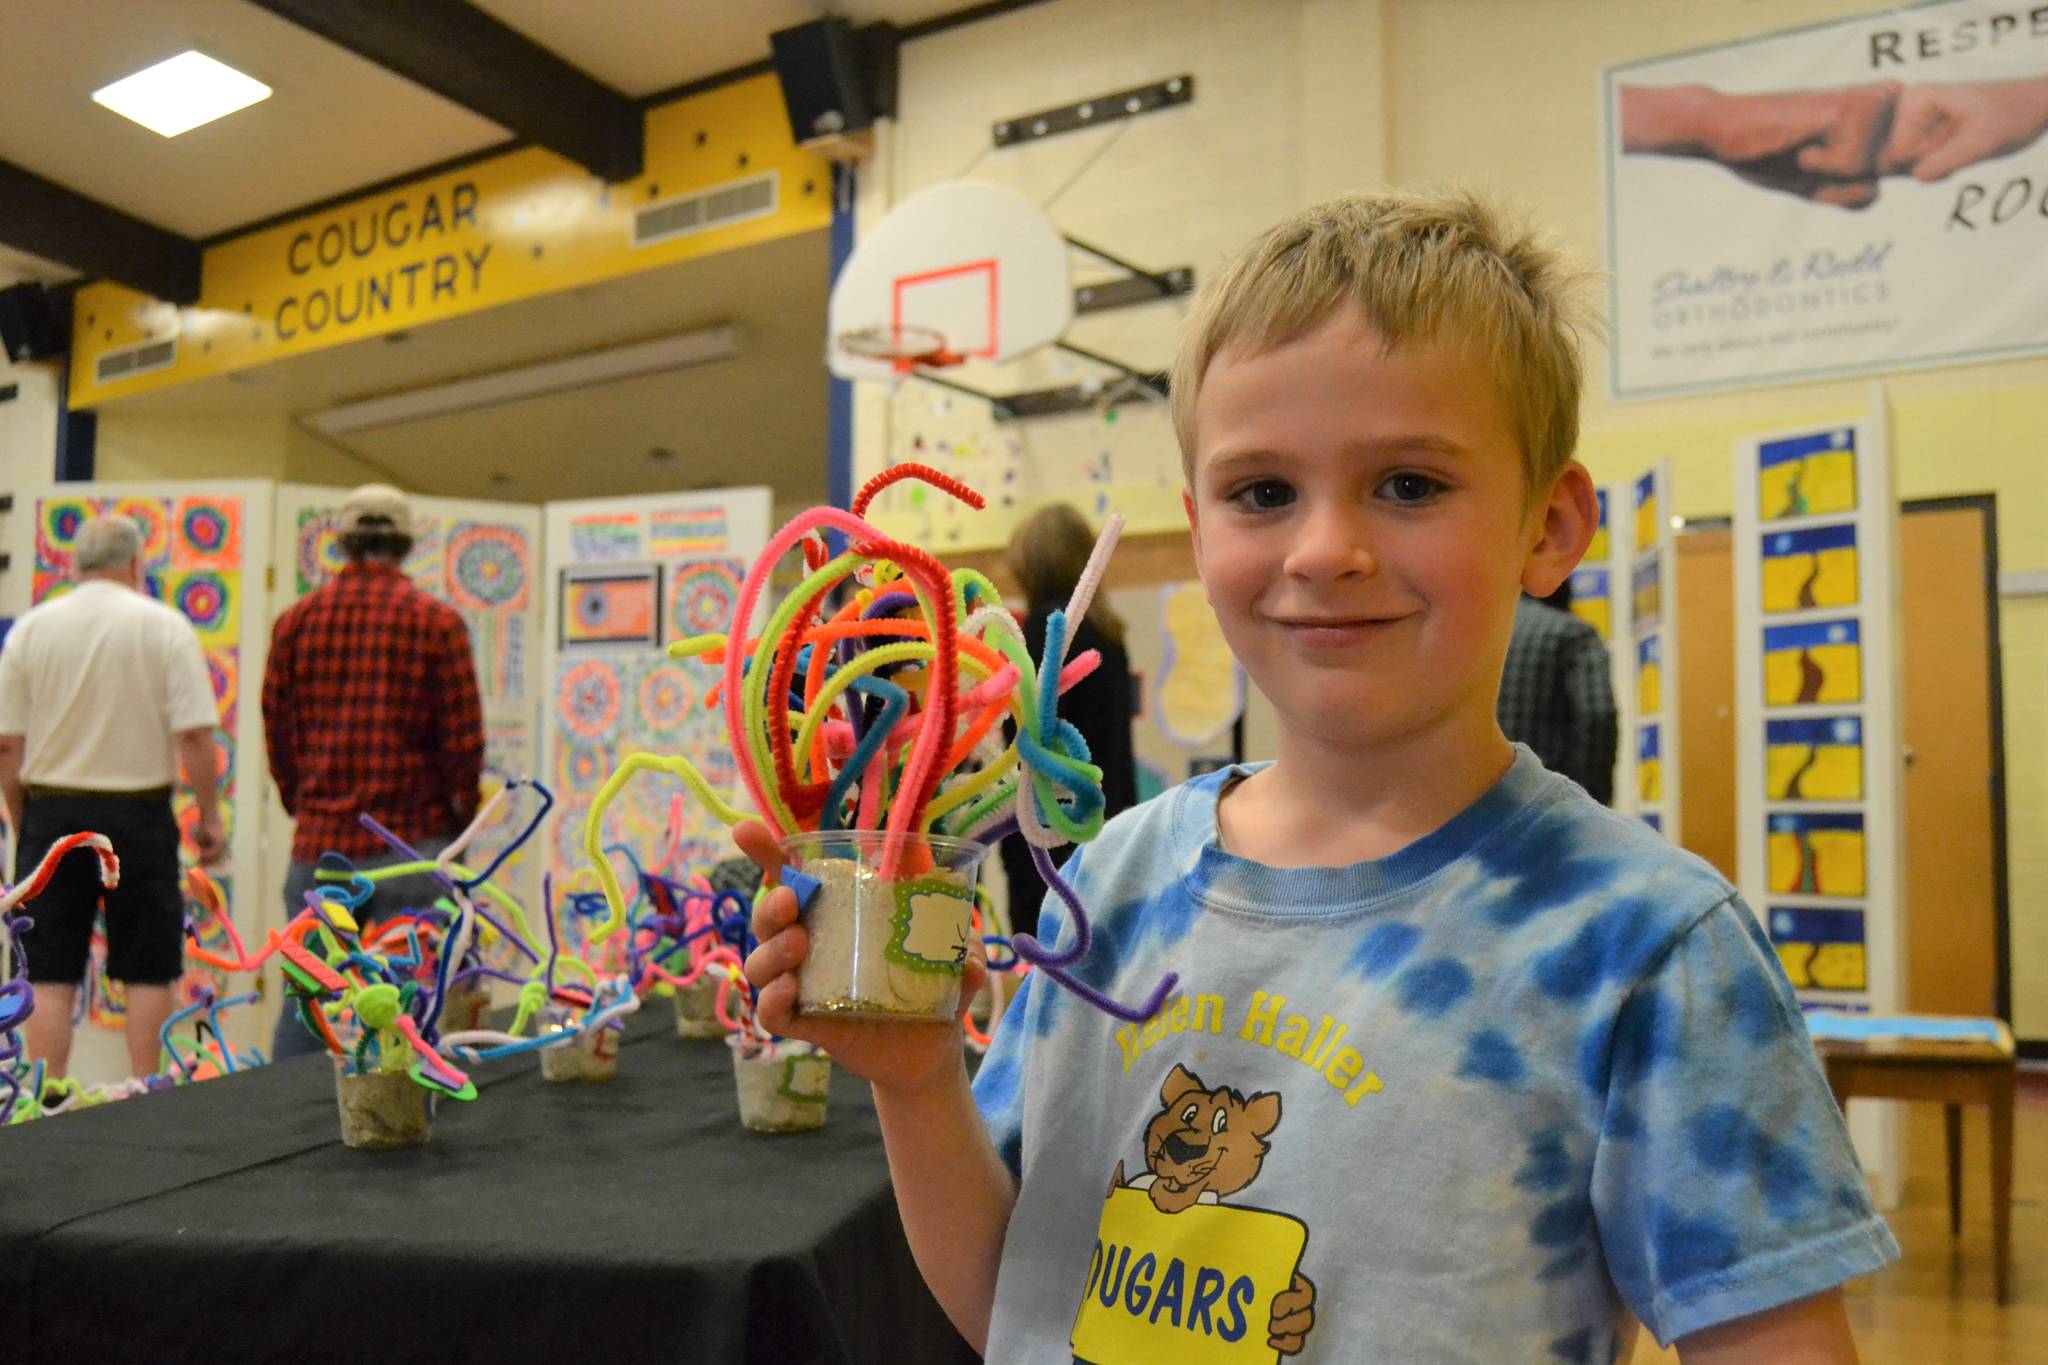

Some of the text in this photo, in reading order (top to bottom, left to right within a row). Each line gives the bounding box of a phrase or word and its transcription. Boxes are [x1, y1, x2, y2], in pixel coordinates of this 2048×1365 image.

[1869, 7, 2048, 68] RESPE
[287, 183, 478, 276] COUGAR
[1947, 176, 2048, 232] RO
[274, 244, 492, 341] COUNTRY
[1652, 279, 1890, 331] ORTHODONTICS
[1114, 990, 1385, 1108] Helen Haller
